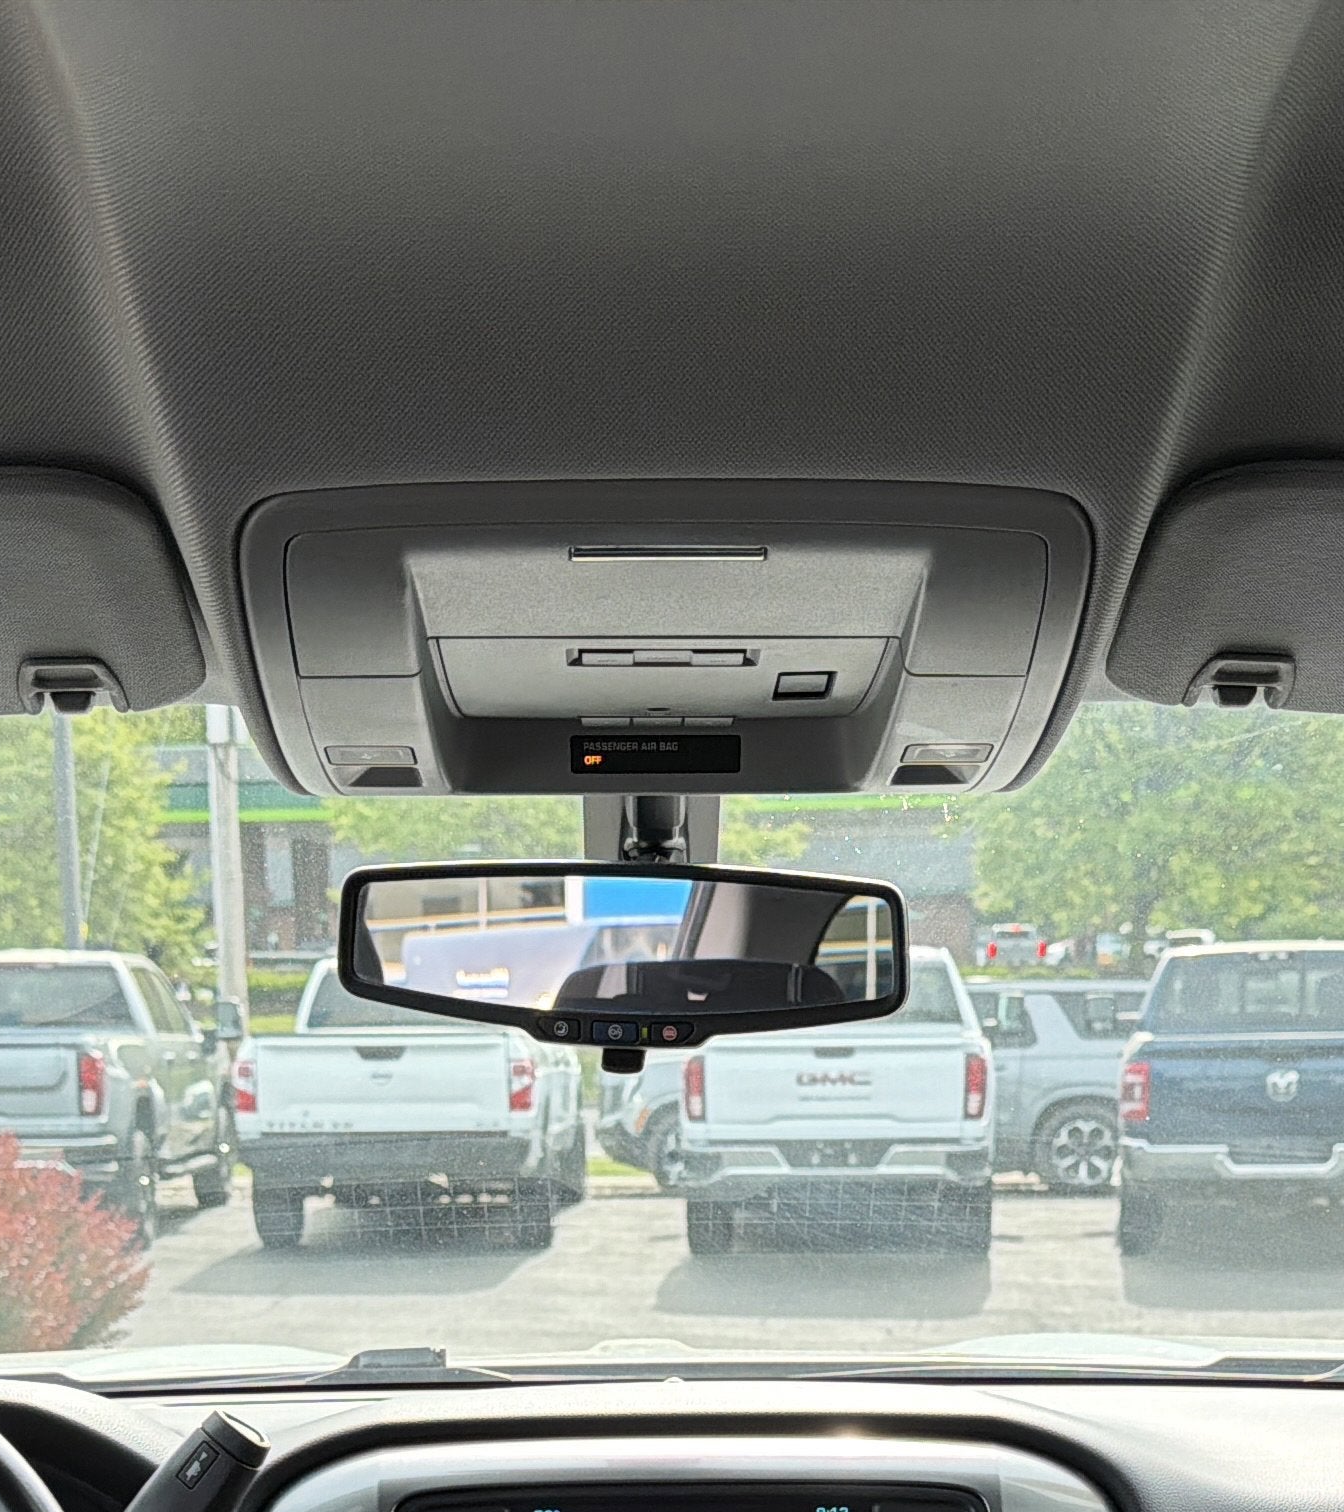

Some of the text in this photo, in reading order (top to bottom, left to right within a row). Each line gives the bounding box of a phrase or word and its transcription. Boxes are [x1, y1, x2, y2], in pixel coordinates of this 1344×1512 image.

[582, 741, 679, 751] PASSENGER AIR BAG
[583, 755, 602, 766] OFF
[795, 1071, 872, 1087] GMC
